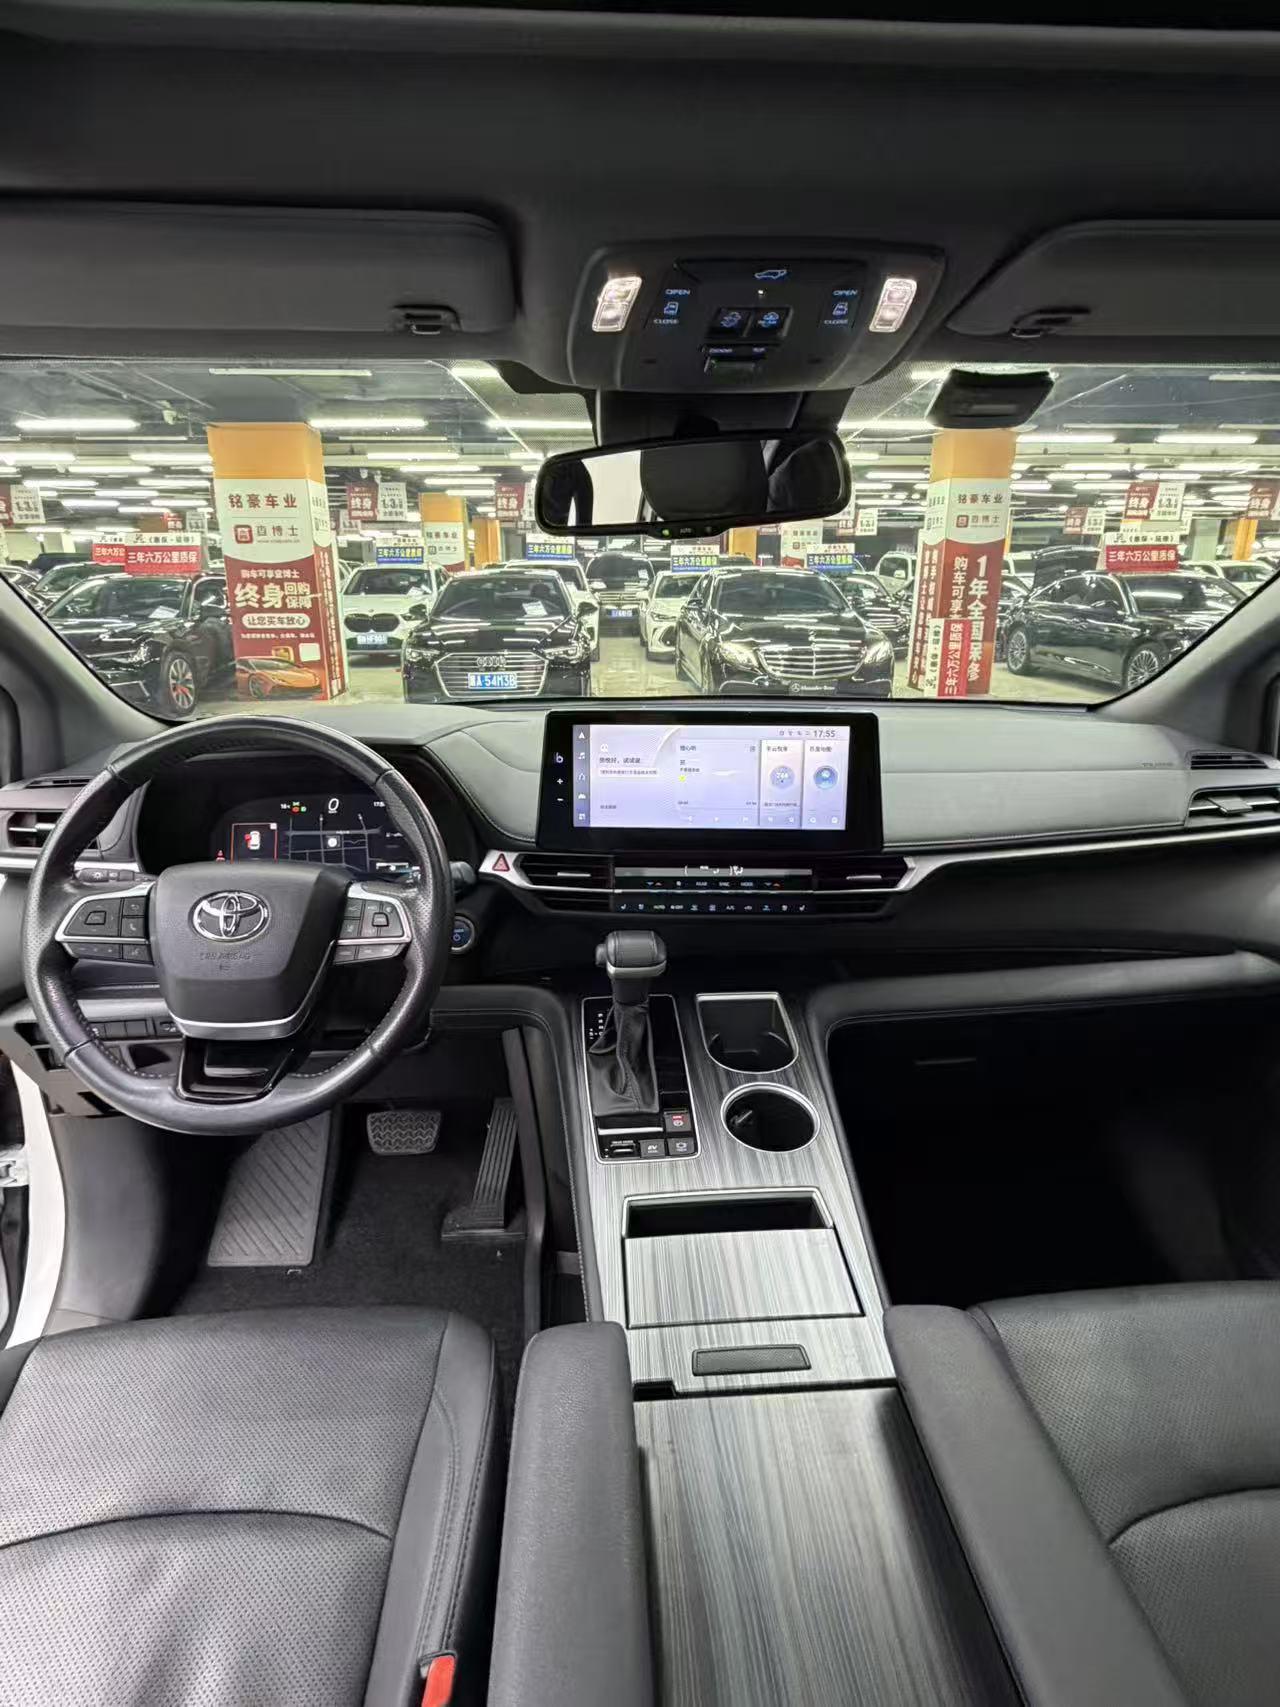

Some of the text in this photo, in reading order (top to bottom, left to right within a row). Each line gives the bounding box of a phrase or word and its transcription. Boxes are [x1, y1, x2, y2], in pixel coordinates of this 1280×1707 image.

[228, 493, 297, 509] 铭豪车业
[128, 551, 198, 564] 三年六万公里质保
[1108, 549, 1176, 562] 三年六万公里质保
[284, 582, 311, 595] 回购
[234, 582, 284, 609] 终身
[285, 595, 313, 609] 保障
[248, 615, 305, 626] 让您买车放心
[813, 730, 836, 738] 17:55
[328, 798, 339, 811] 0
